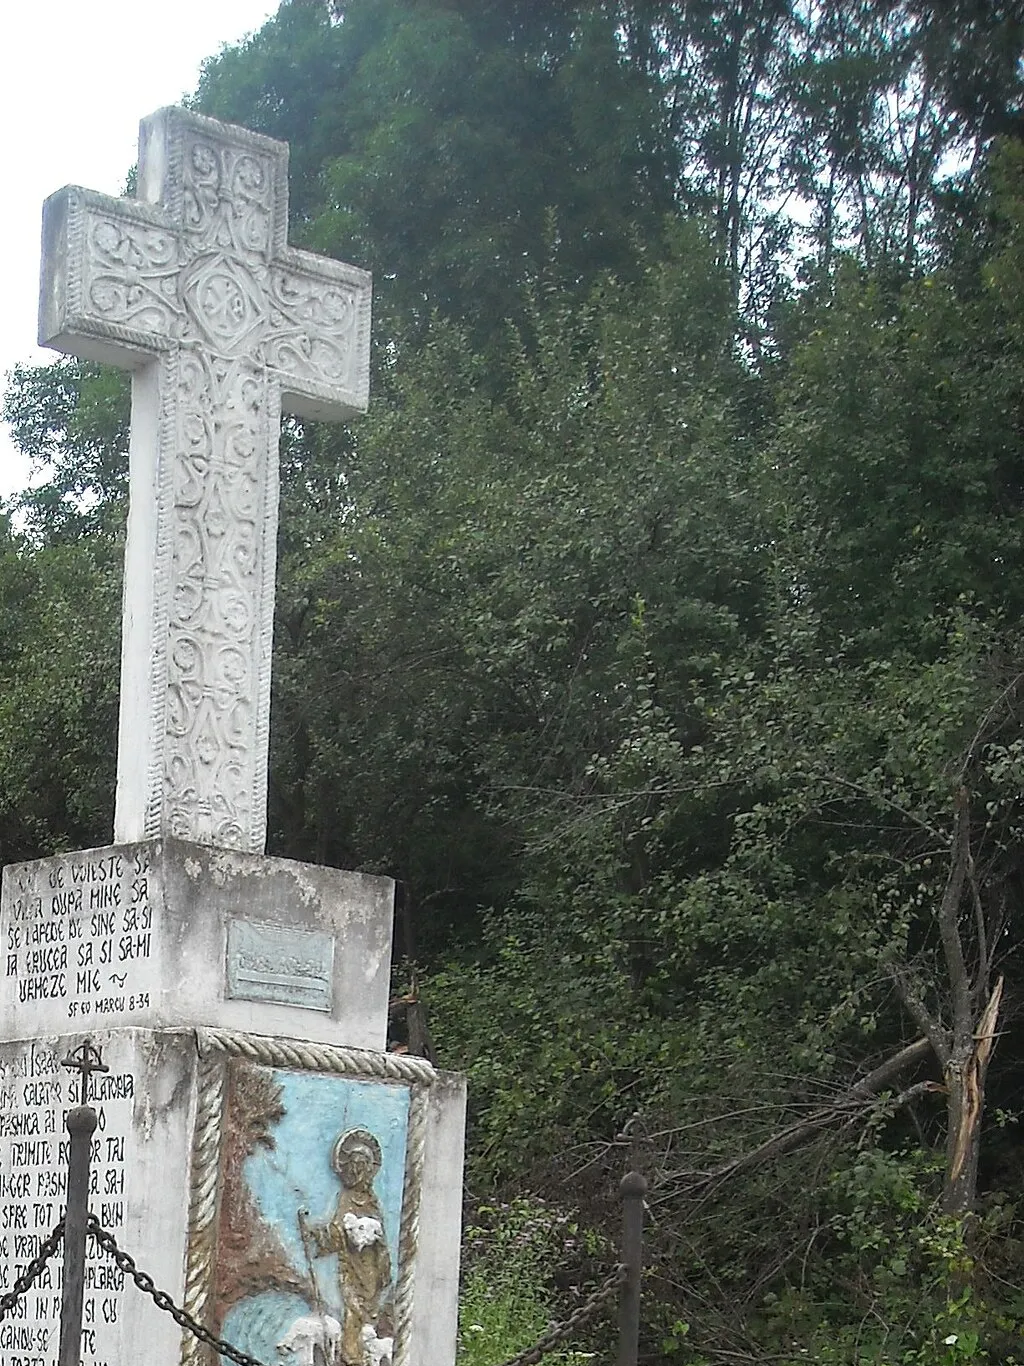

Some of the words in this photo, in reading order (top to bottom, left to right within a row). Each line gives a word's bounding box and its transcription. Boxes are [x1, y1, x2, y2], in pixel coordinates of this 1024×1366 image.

[52, 889, 82, 915] DUPA
[90, 883, 121, 909] MINE
[132, 878, 148, 903] SA
[8, 926, 20, 950] SE
[91, 912, 115, 936] SINE
[77, 942, 93, 967] SA
[100, 940, 112, 963] SI
[76, 969, 101, 994] MIE
[95, 996, 125, 1013] MARCU
[129, 993, 150, 1010] 8-34
[88, 1074, 134, 1102] ALATORIA
[2, 1203, 28, 1229] SPRE
[33, 1203, 53, 1227] TOT
[101, 1201, 123, 1228] BUN
[15, 1264, 53, 1289] TOTA
[36, 1296, 48, 1319] IN
[85, 1298, 95, 1322] SI
[102, 1298, 118, 1323] CU
